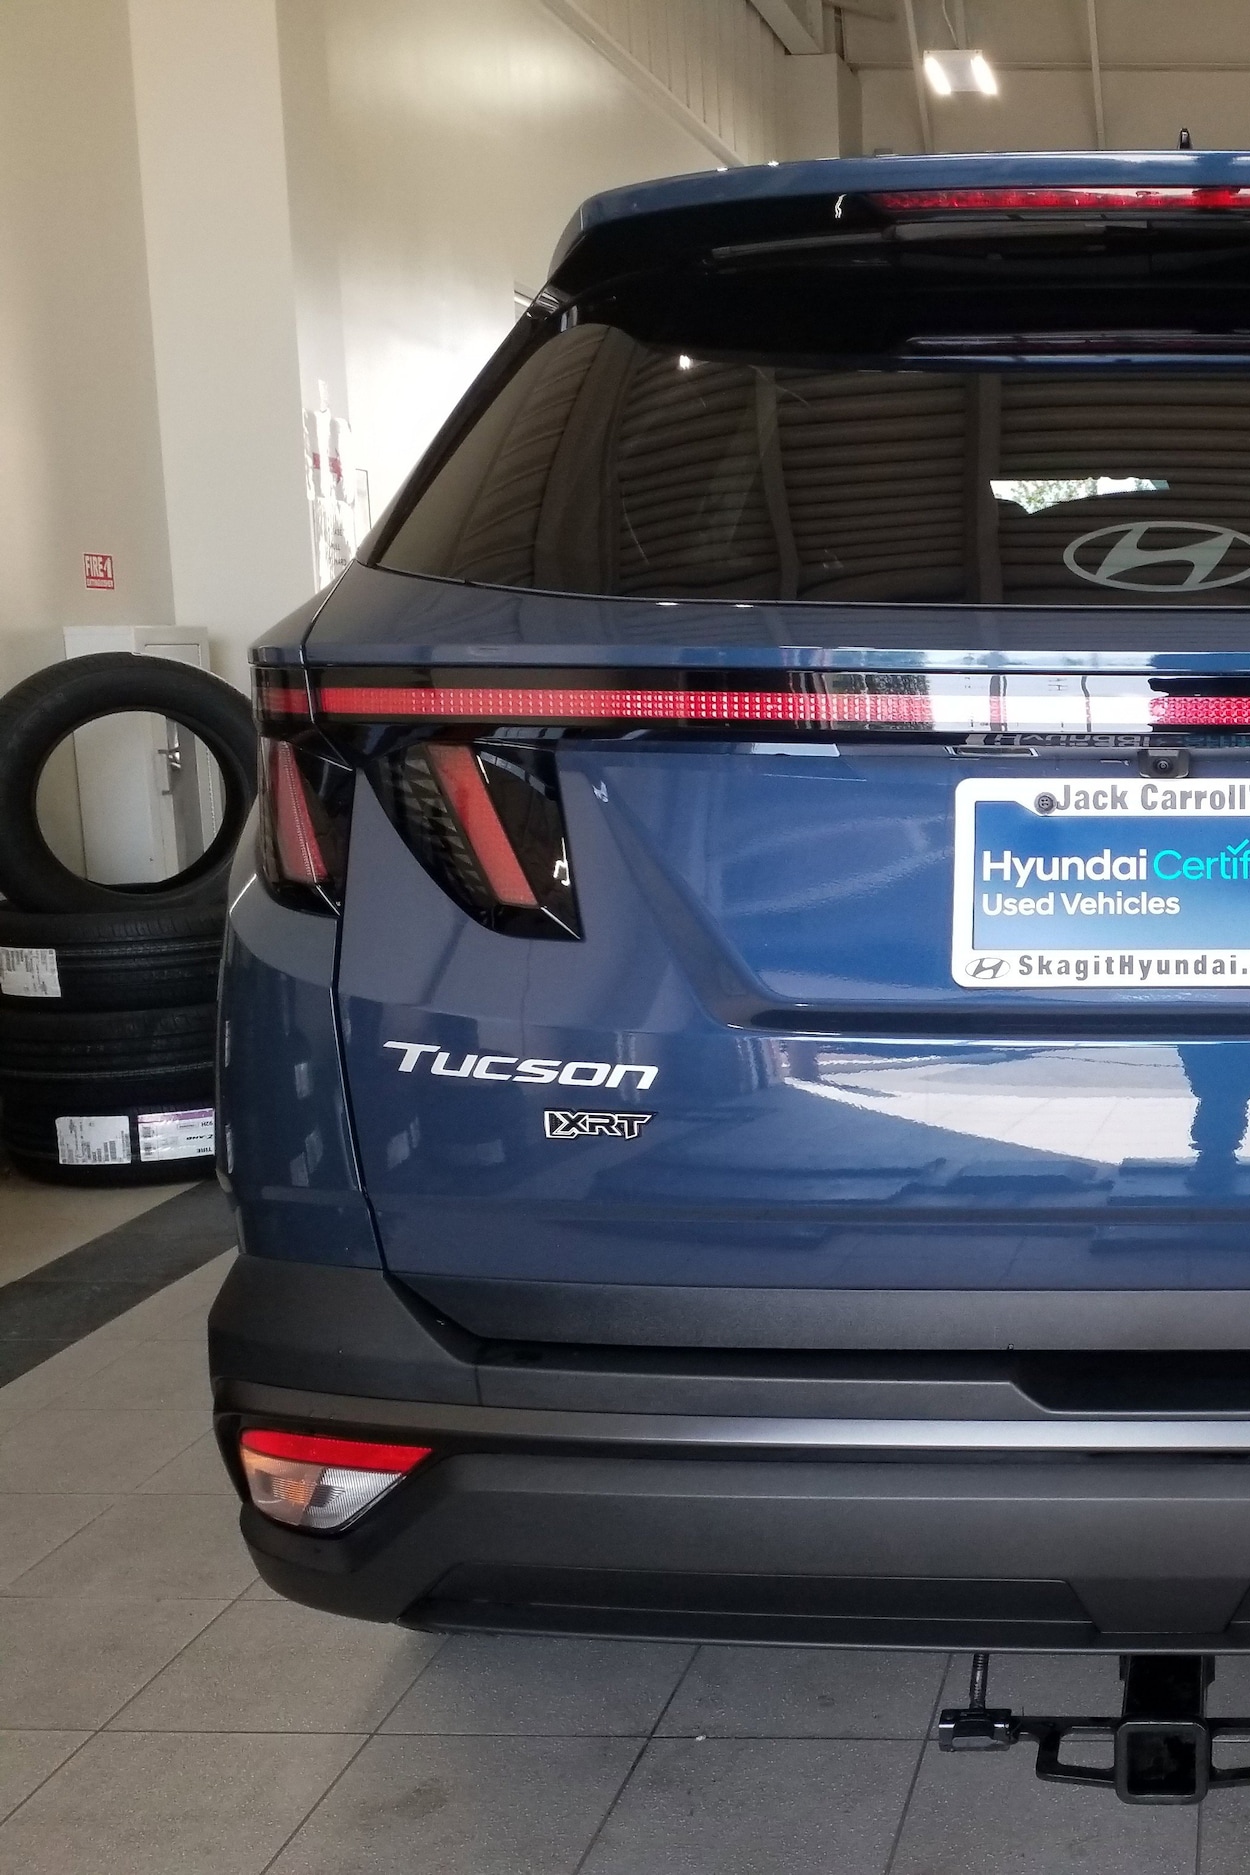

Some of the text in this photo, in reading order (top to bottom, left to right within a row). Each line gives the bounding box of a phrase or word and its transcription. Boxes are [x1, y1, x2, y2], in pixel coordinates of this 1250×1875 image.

[85, 555, 105, 578] FIRE
[1056, 784, 1129, 811] Jack
[982, 848, 1148, 888] Hyundai
[982, 891, 1181, 916] Used Vehicles
[545, 1110, 653, 1140] XRT
